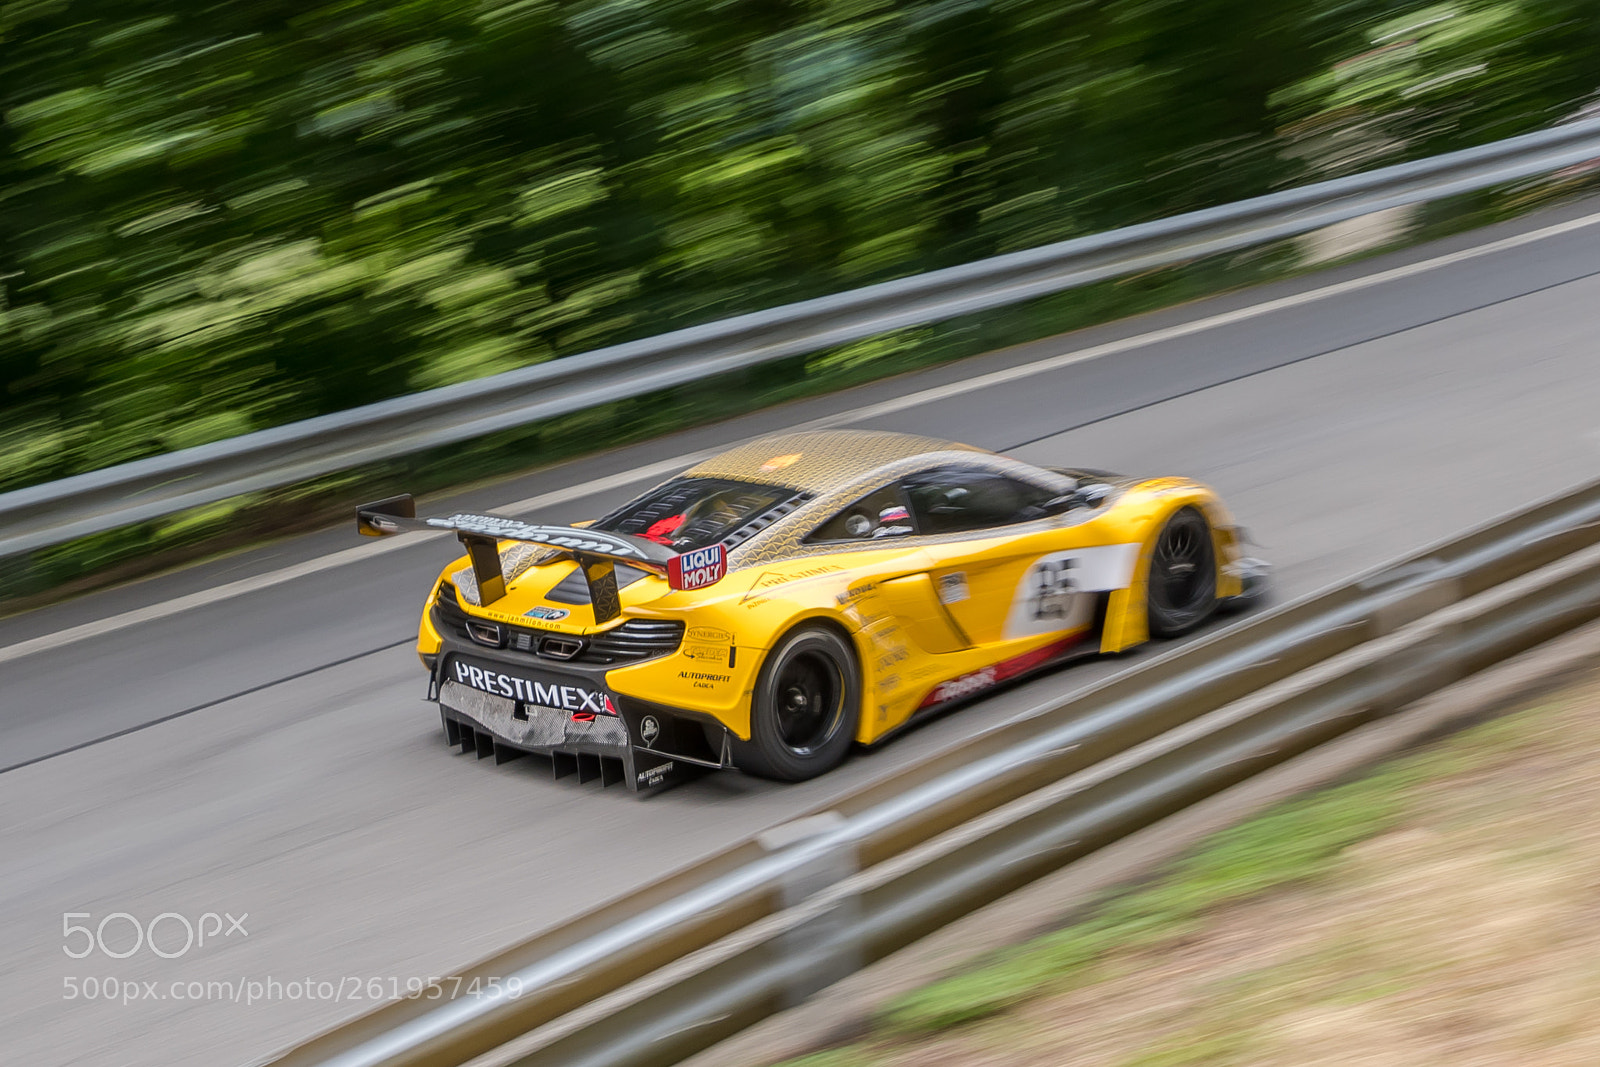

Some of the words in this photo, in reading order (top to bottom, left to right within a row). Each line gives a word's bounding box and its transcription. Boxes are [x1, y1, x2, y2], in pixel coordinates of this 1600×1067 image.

[682, 547, 720, 572] LIQUI
[683, 563, 720, 589] MOLY
[455, 660, 601, 713] PRESTIMEX
[677, 671, 732, 683] AUTOPROFIT
